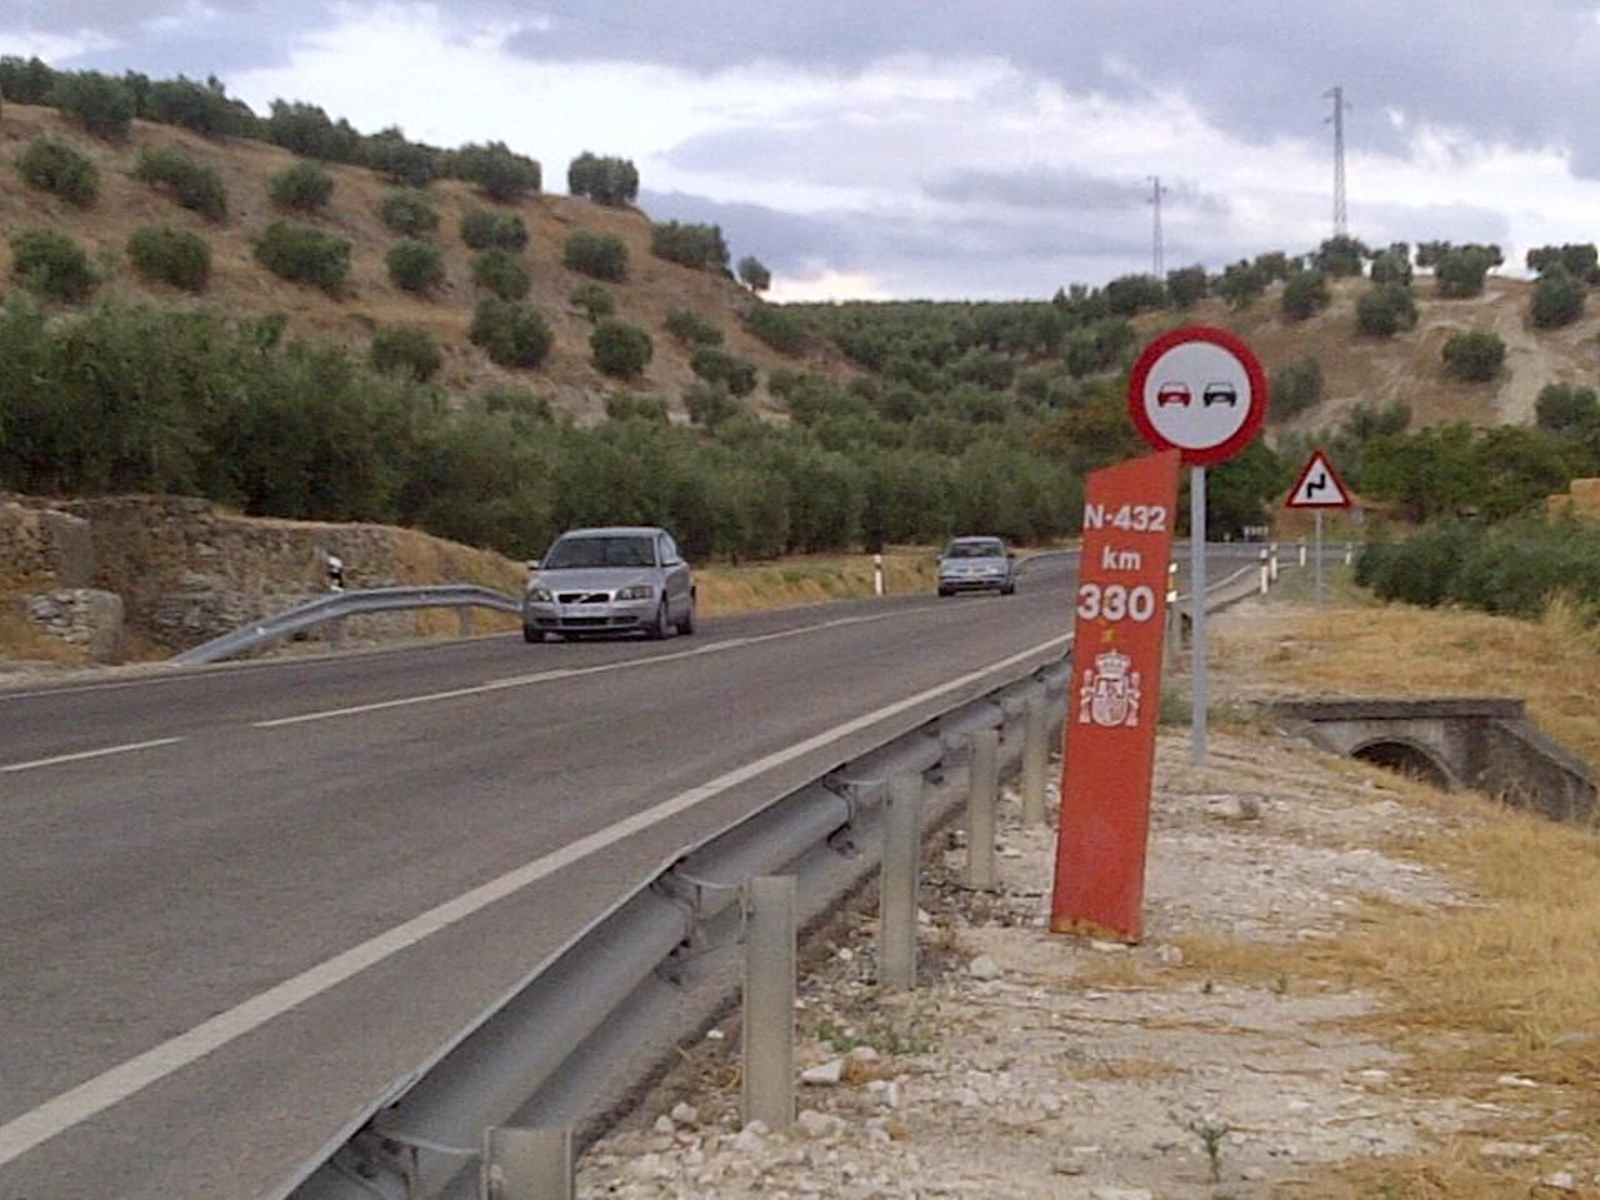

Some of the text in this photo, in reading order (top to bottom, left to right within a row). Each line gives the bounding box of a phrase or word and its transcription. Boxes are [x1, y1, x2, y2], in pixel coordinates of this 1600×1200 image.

[1083, 504, 1167, 533] N-432
[1102, 546, 1141, 570] km
[1077, 583, 1155, 622] 330
